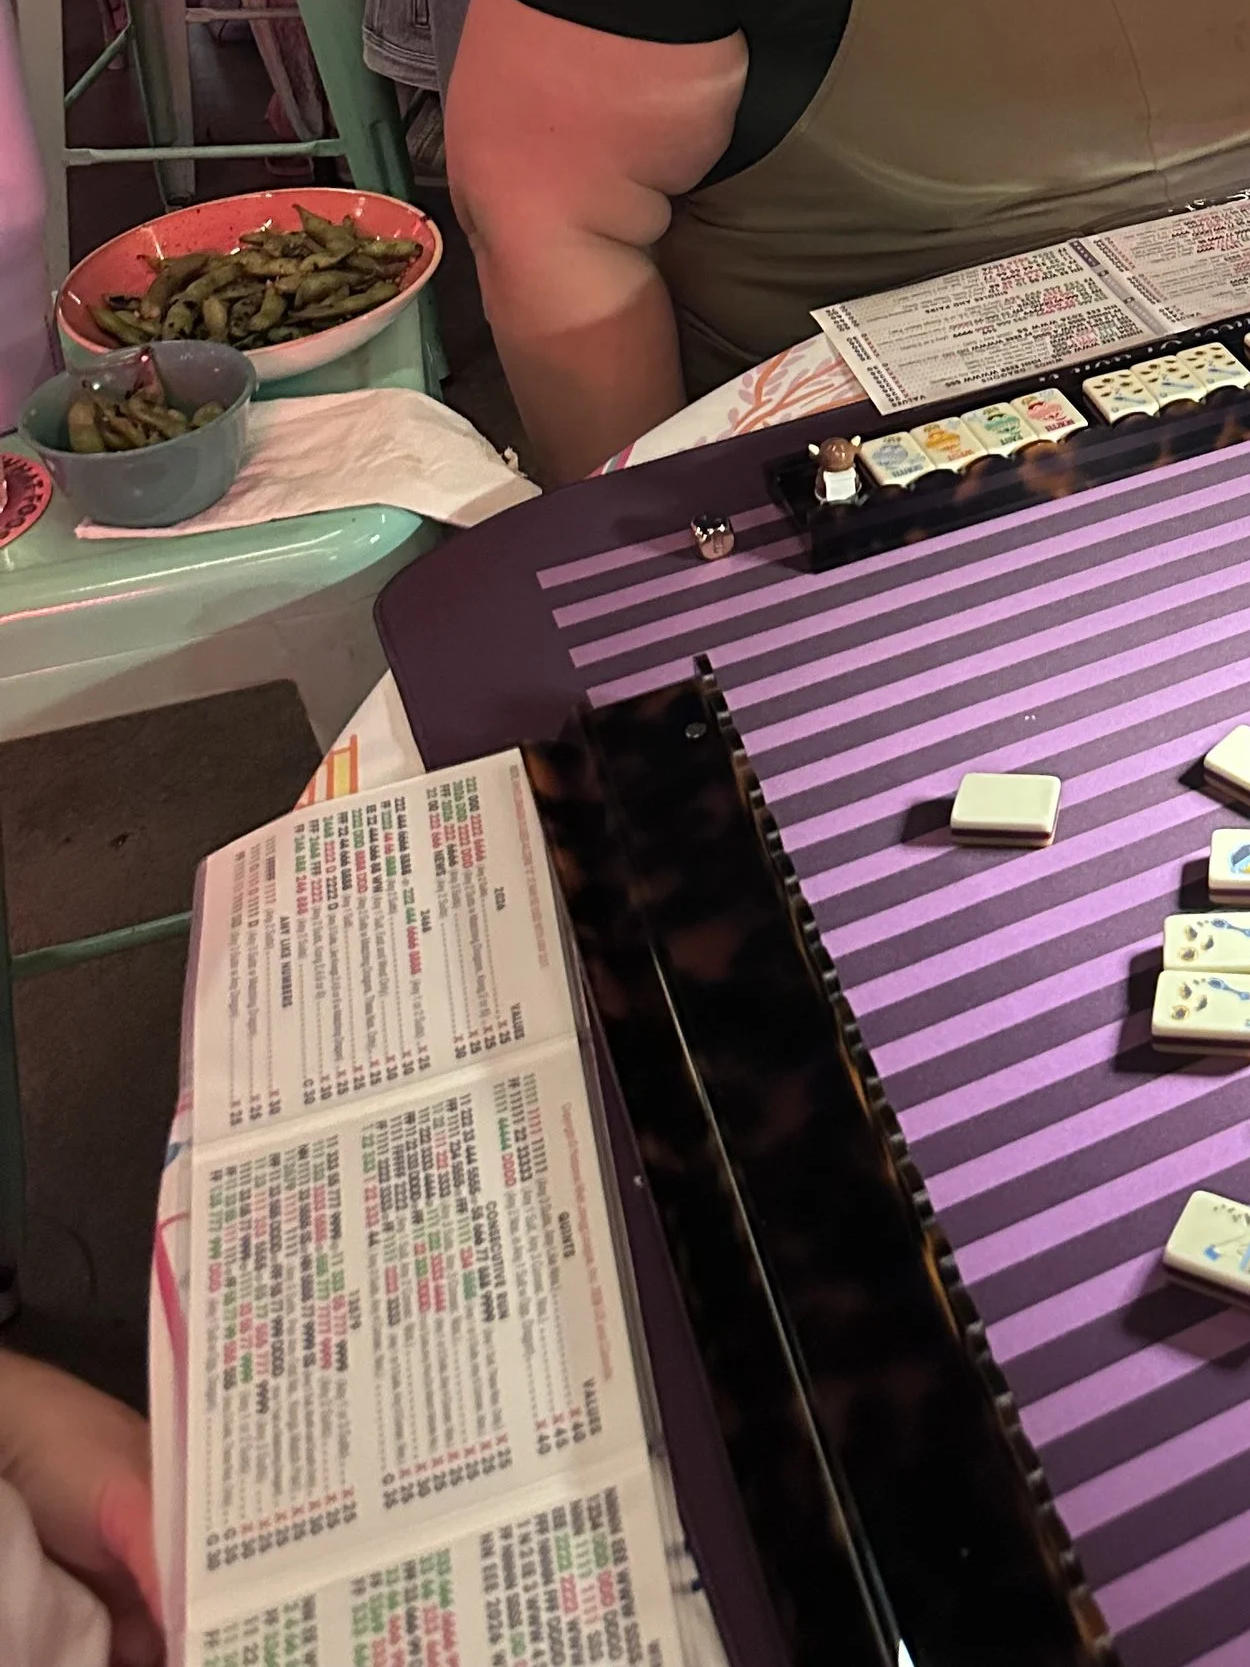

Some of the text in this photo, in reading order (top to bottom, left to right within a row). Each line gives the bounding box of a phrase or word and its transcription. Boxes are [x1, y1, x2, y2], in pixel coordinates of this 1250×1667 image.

[419, 908, 432, 933] 2468
[279, 913, 293, 1009] ANY LIKE NUMBERS
[432, 848, 446, 877] NEWS
[454, 1044, 467, 1059] 30
[509, 1002, 525, 1041] VALUES
[483, 1034, 496, 1050] 25
[498, 1029, 511, 1045] 25
[469, 1039, 481, 1055] 25
[401, 1059, 415, 1076] 30
[417, 1054, 431, 1071] 25
[369, 1069, 382, 1086] 25
[385, 1064, 398, 1081] 30
[336, 1078, 349, 1096] 25
[353, 1074, 365, 1091] 25
[303, 1088, 315, 1105] 30
[319, 1083, 332, 1100] 30
[557, 1210, 575, 1259] QUINTS
[485, 1199, 505, 1288] CONSECUTIVE
[495, 1290, 509, 1320] RUN
[581, 1377, 602, 1435] VALUES
